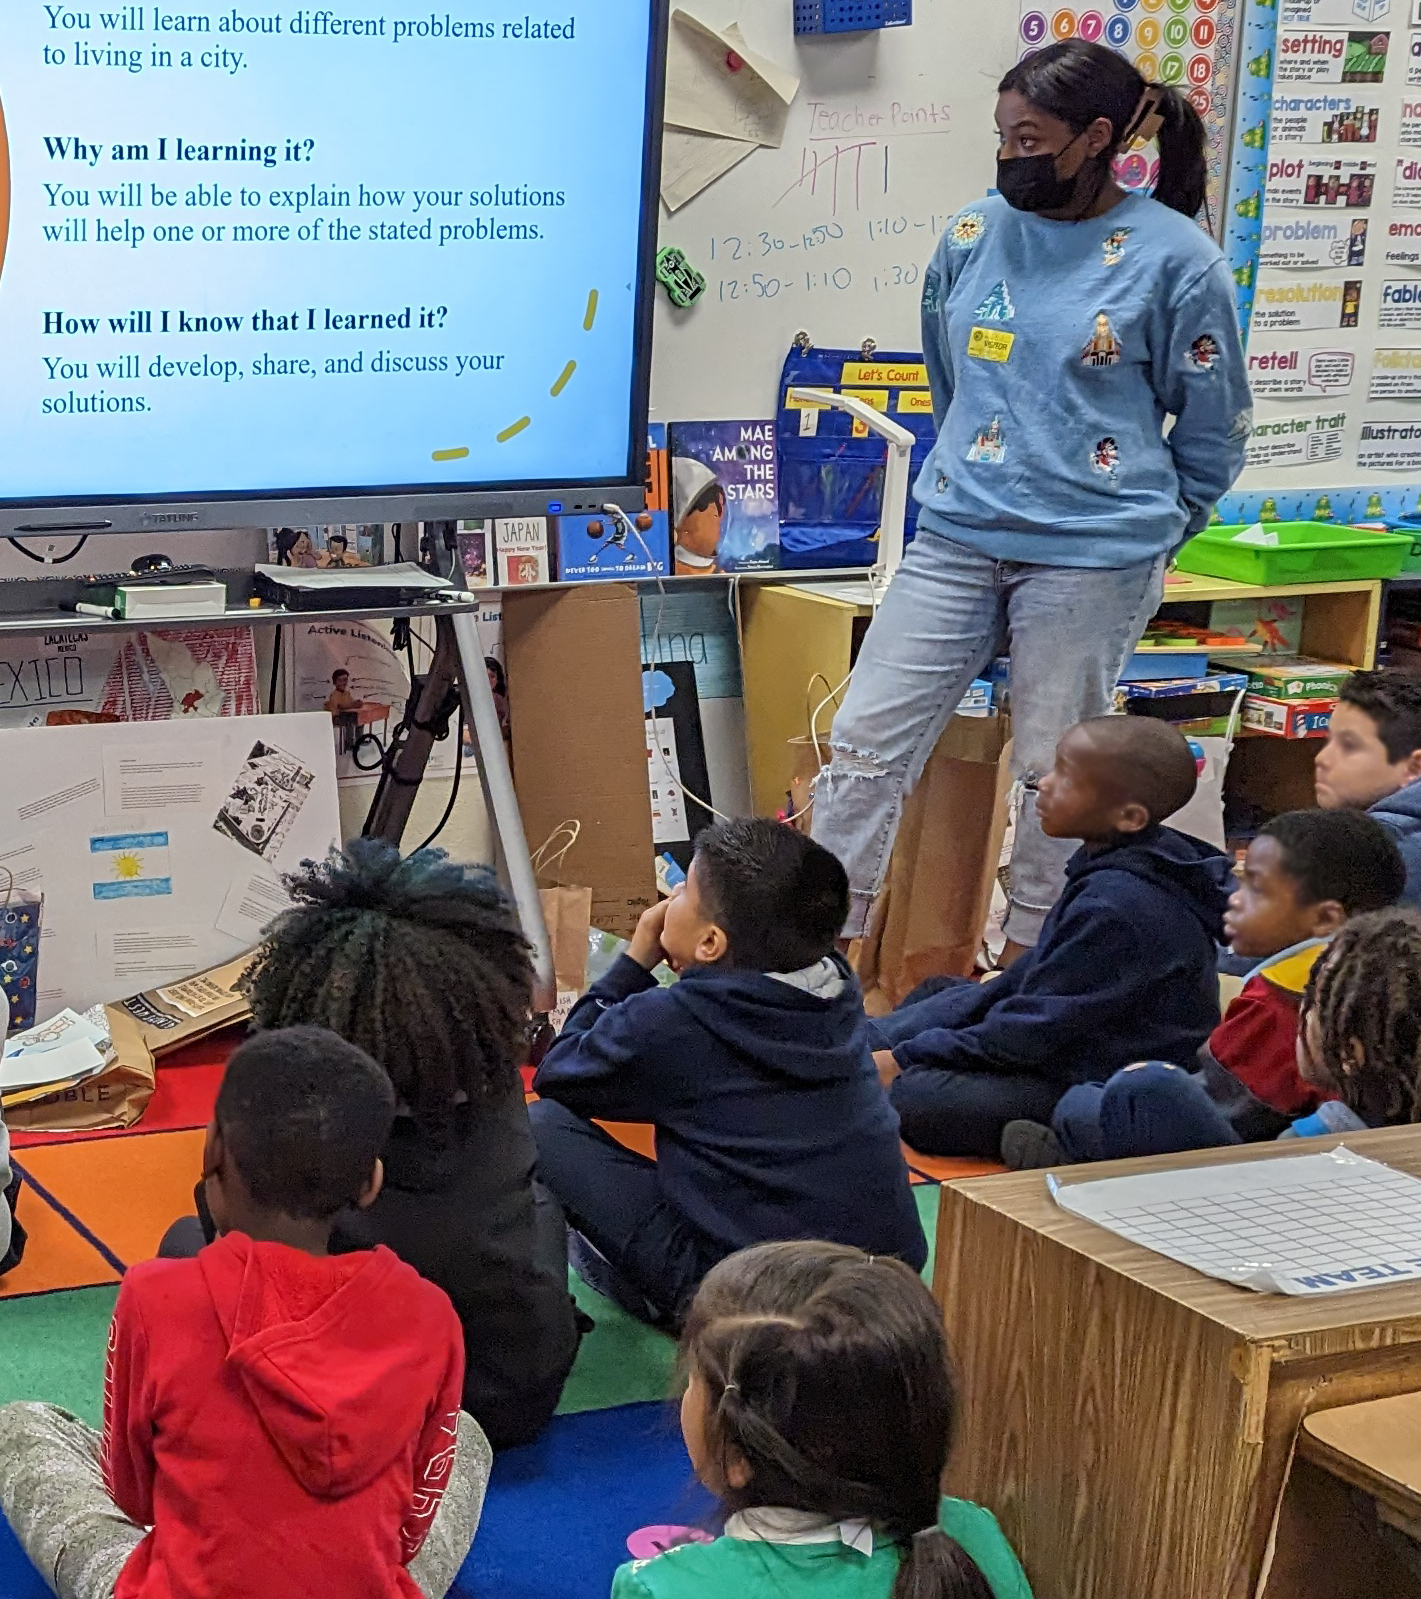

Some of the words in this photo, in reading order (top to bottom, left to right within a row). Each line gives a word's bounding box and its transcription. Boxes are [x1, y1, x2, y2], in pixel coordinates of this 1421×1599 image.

[43, 6, 91, 29] You
[100, 6, 145, 31] will
[153, 7, 210, 32] learn
[219, 9, 282, 33] about
[289, 10, 386, 36] different
[392, 14, 494, 43] problems
[502, 16, 575, 39] related
[1029, 20, 1040, 36] 5
[1059, 18, 1069, 33] 6
[1086, 20, 1096, 35] 7
[1113, 24, 1123, 39] 8
[1170, 25, 1184, 39] 10
[1199, 25, 1208, 39] 11
[1143, 27, 1153, 42] 9
[1281, 33, 1344, 59] setting
[43, 44, 65, 65] to
[74, 41, 143, 73] living
[151, 43, 173, 67] in
[180, 49, 193, 67] a
[200, 44, 248, 74] city.
[1165, 61, 1179, 76] 17
[1193, 63, 1206, 78] 18
[1191, 94, 1207, 110] 25
[1273, 95, 1352, 111] characters
[807, 102, 884, 133] Teacher
[891, 102, 952, 127] Points
[42, 136, 103, 167] Why
[111, 143, 149, 161] am
[157, 138, 168, 160] I
[176, 138, 277, 168] learning
[284, 138, 315, 162] it?
[1269, 158, 1304, 182] plot
[42, 183, 90, 207] You
[97, 182, 142, 207] will
[150, 182, 177, 207] be
[184, 182, 232, 207] able
[239, 186, 261, 207] to
[269, 183, 351, 213] explain
[358, 183, 405, 207] how
[412, 189, 463, 213] your
[469, 183, 565, 207] solutions
[42, 217, 88, 242] will
[95, 218, 145, 248] help
[153, 223, 194, 242] one
[201, 223, 226, 242] or
[232, 223, 290, 242] more
[297, 217, 324, 241] of
[328, 217, 361, 241] the
[368, 217, 432, 241] stated
[439, 217, 544, 246] problems.
[1262, 220, 1338, 245] problem
[42, 311, 101, 334] How
[108, 310, 152, 333] will
[160, 310, 171, 332] I
[178, 310, 244, 333] know
[252, 309, 299, 331] that
[306, 308, 316, 330] I
[324, 307, 411, 330] learned
[419, 306, 448, 329] it?
[42, 356, 89, 380] You
[96, 355, 141, 379] will
[148, 354, 244, 382] develop,
[252, 353, 317, 378] share,
[324, 351, 364, 374] and
[370, 350, 448, 372] discuss
[454, 354, 505, 377] your
[1248, 351, 1299, 371] retell
[857, 368, 883, 381] Let's
[887, 369, 919, 382] Count
[42, 390, 152, 414] solutions.
[1315, 413, 1347, 431] trait
[740, 425, 773, 441] MAE
[744, 464, 774, 480] THE
[728, 484, 775, 500] STARS
[503, 522, 540, 543] JAPAN
[307, 624, 347, 636] Active
[1292, 1263, 1413, 1288] TEAM
